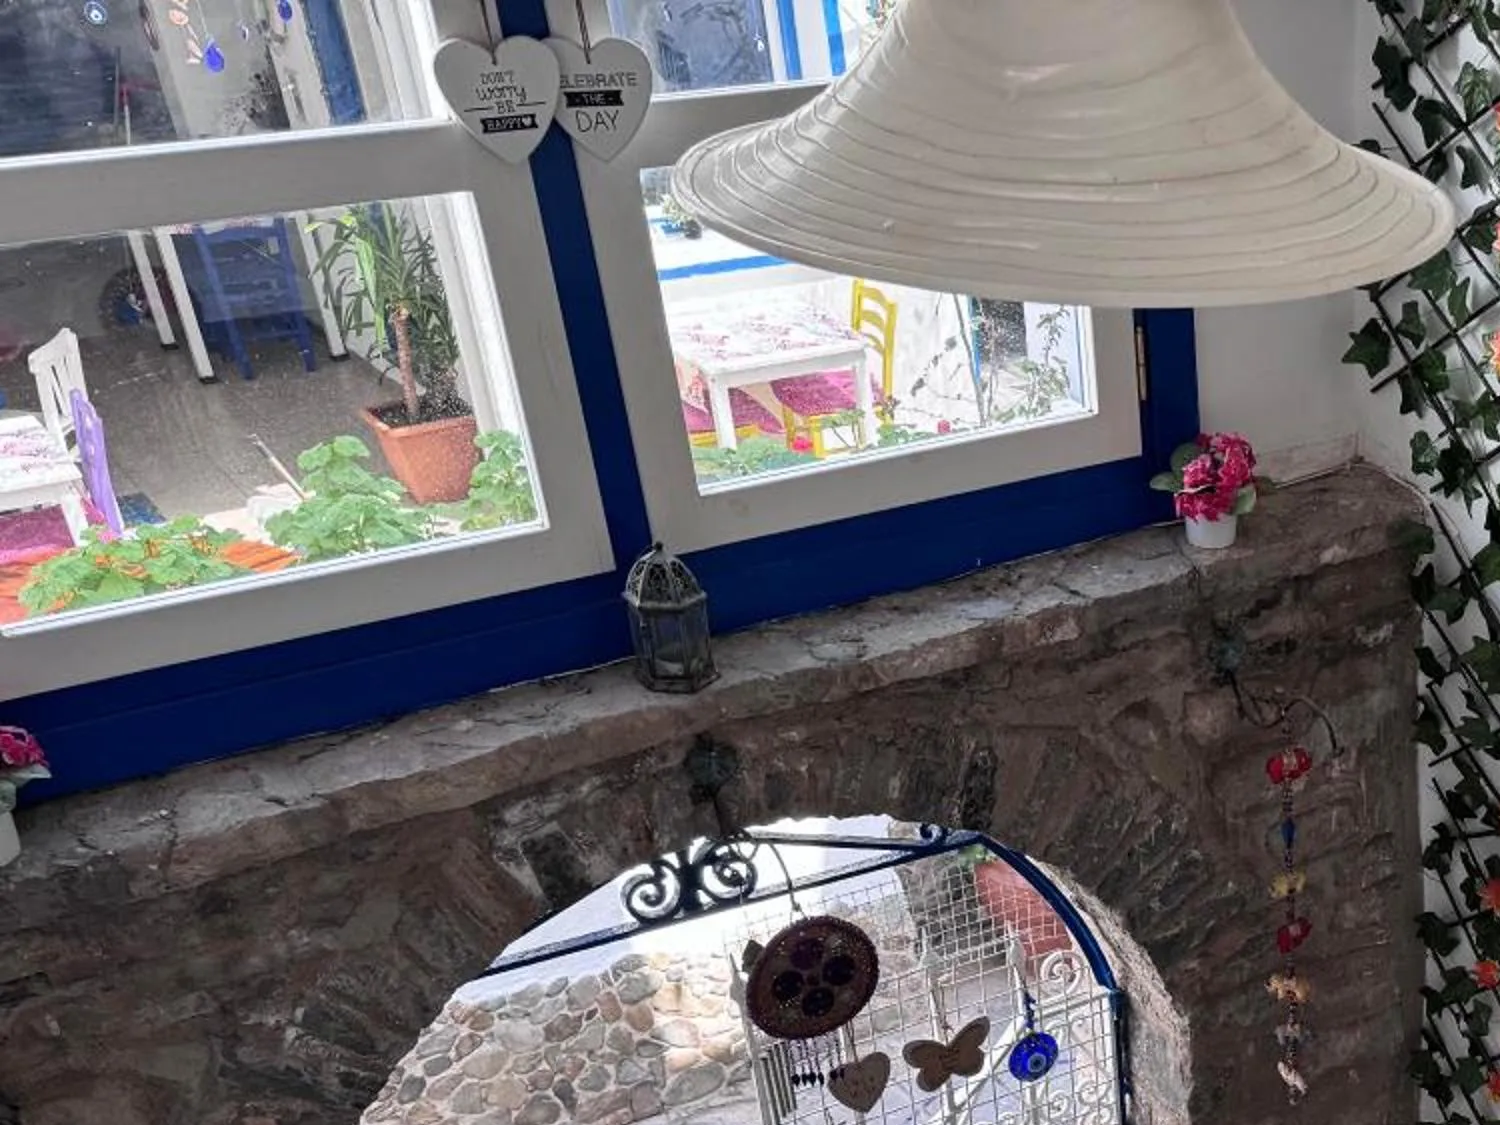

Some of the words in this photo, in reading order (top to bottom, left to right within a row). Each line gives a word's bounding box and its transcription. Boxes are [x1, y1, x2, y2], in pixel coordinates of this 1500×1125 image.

[560, 71, 638, 89] ELEBRATE
[495, 99, 516, 115] BE
[581, 93, 607, 105] THE
[487, 116, 521, 131] HAPPY
[575, 109, 619, 133] DAY
